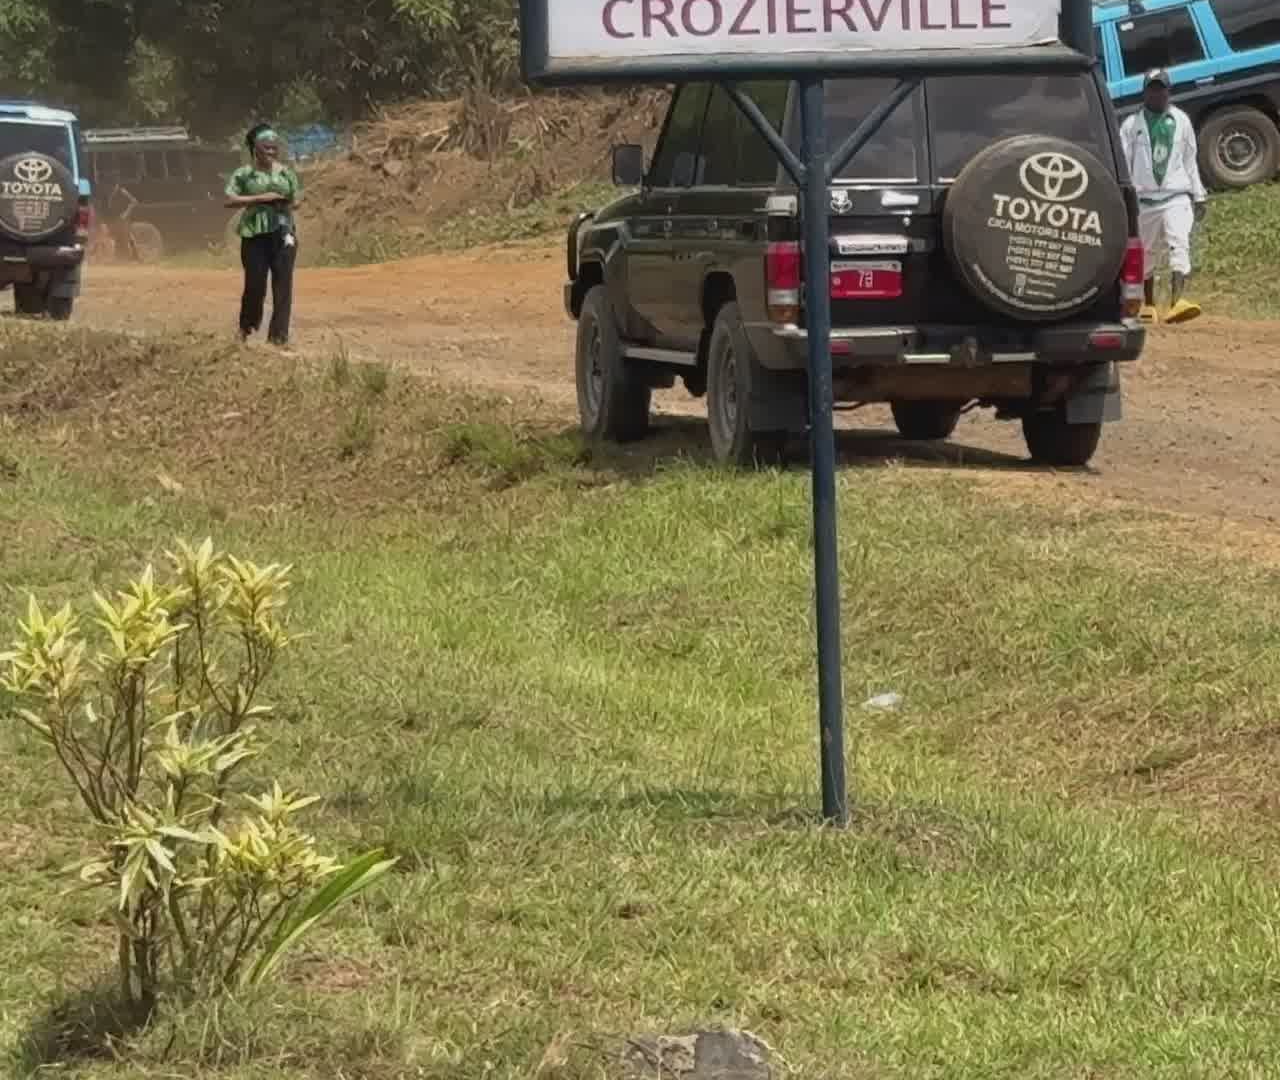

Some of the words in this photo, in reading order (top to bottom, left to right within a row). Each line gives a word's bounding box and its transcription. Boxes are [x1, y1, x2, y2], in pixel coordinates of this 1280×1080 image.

[2, 181, 62, 195] TOYOTA
[992, 193, 1103, 234] TOYOTA
[1014, 221, 1059, 239] MOTORS
